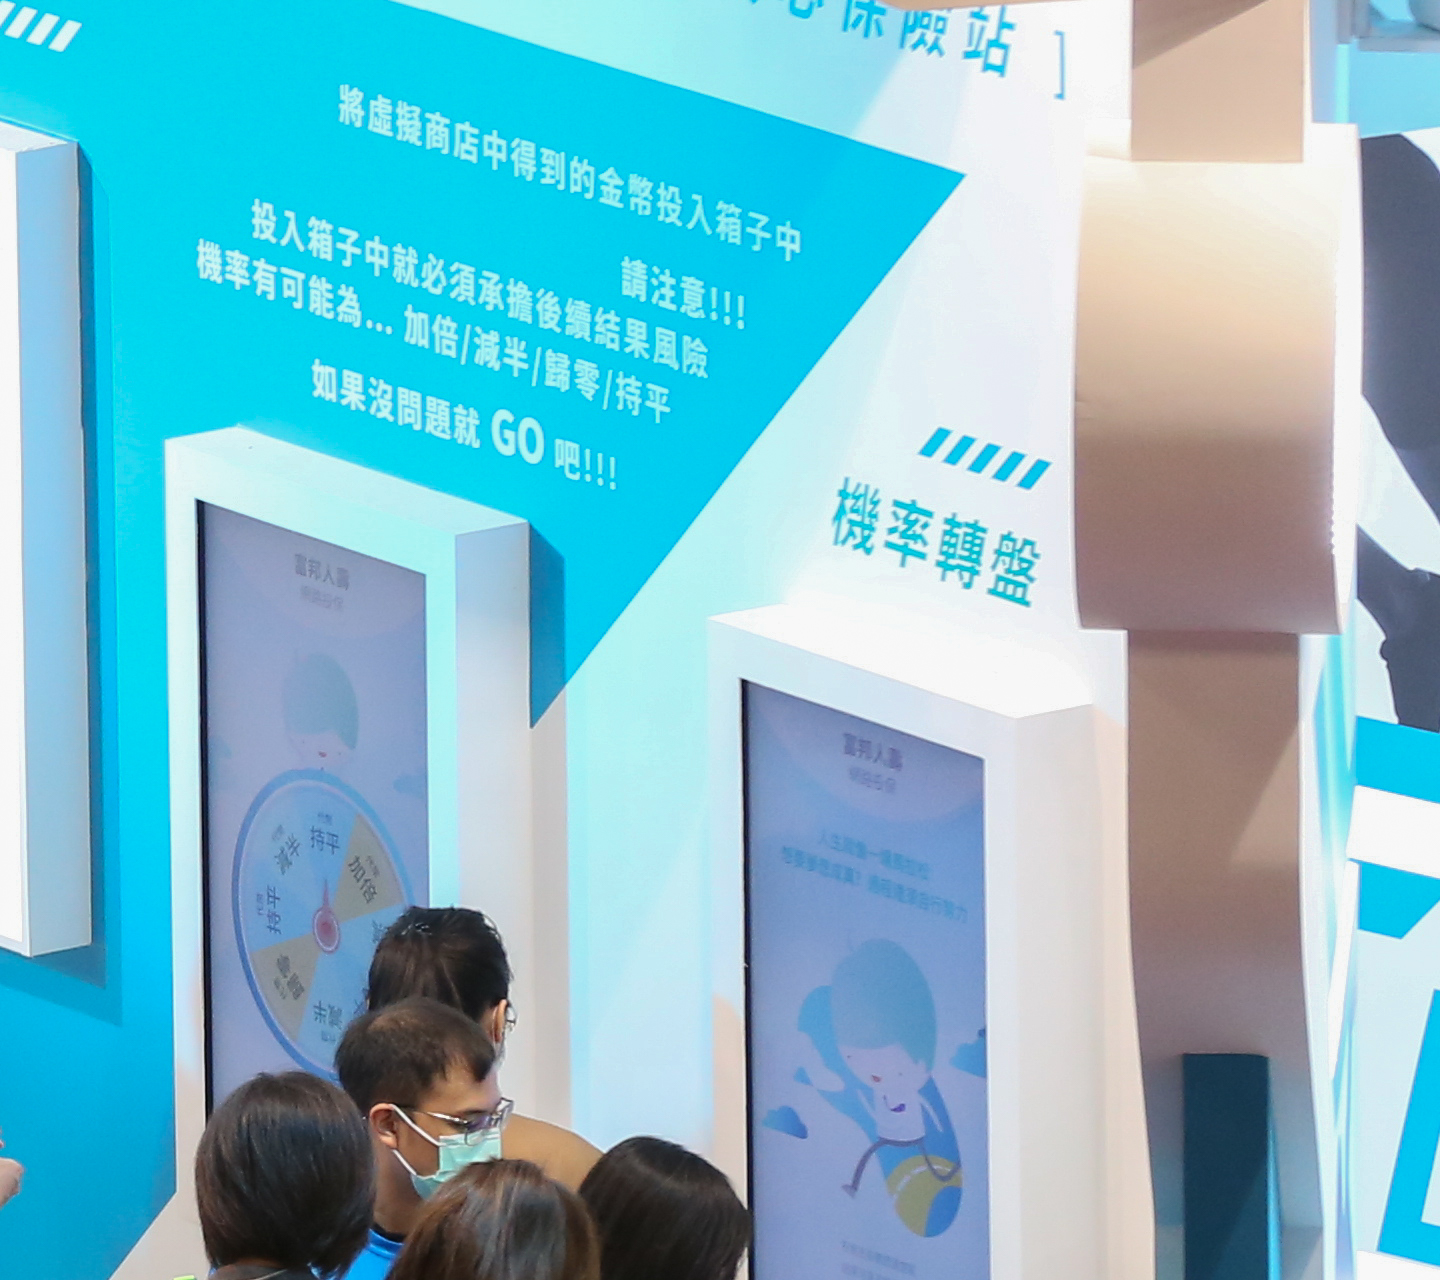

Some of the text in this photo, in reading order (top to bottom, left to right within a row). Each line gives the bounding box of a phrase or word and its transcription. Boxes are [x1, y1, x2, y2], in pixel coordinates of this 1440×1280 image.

[338, 83, 803, 261] 將虛擬商店中得到的金幣投入箱子中
[250, 198, 709, 379] 投入箱子中就必須承擔後續結果風險
[311, 360, 619, 491] 如果沒問題就 GO 吧!!!
[832, 476, 1040, 608] 機率轉盤
